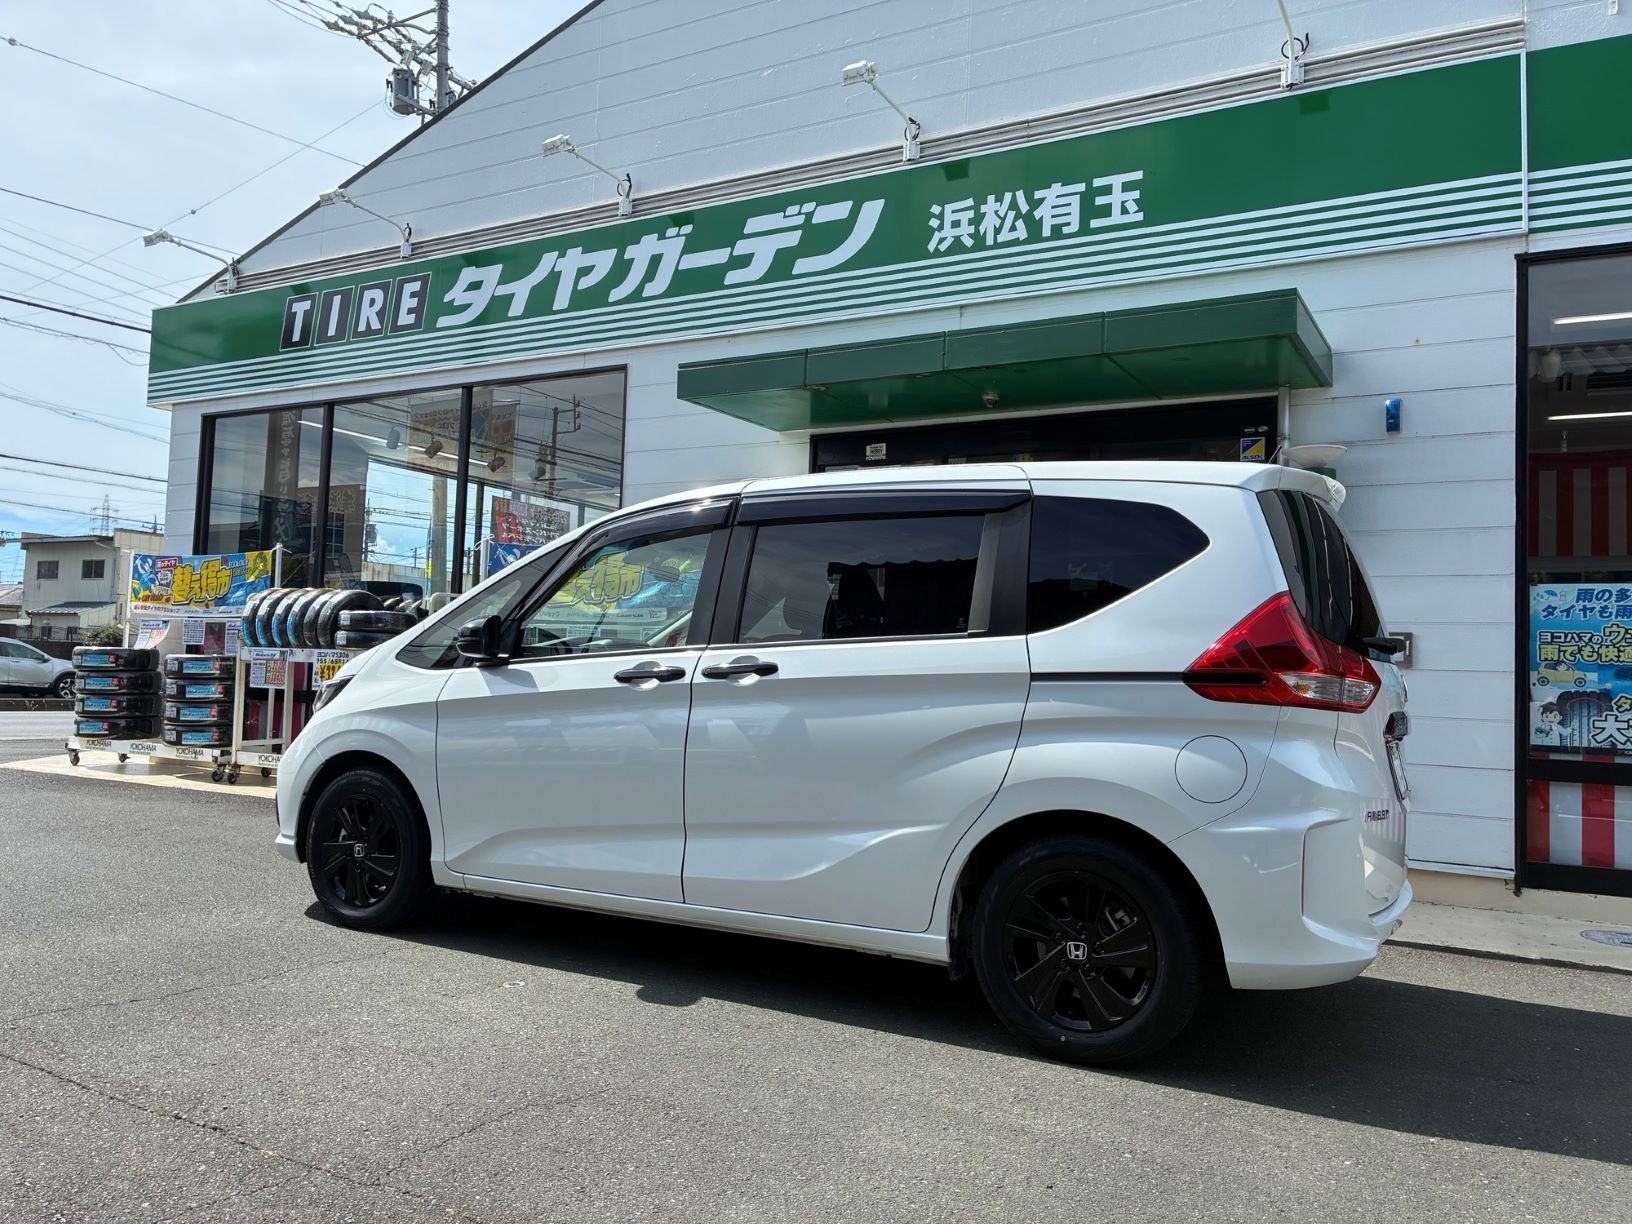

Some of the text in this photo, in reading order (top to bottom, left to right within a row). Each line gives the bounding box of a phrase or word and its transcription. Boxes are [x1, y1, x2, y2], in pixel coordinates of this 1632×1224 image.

[927, 169, 1145, 254] 浜松有玉
[288, 198, 886, 344] TIRE タイヤガーデン
[1576, 588, 1632, 604] 雨の多
[1591, 714, 1632, 745] 大
[129, 743, 157, 752] YOKOHAMA
[175, 747, 204, 757] YOKOHAMA
[257, 754, 282, 763] YOKOHA
